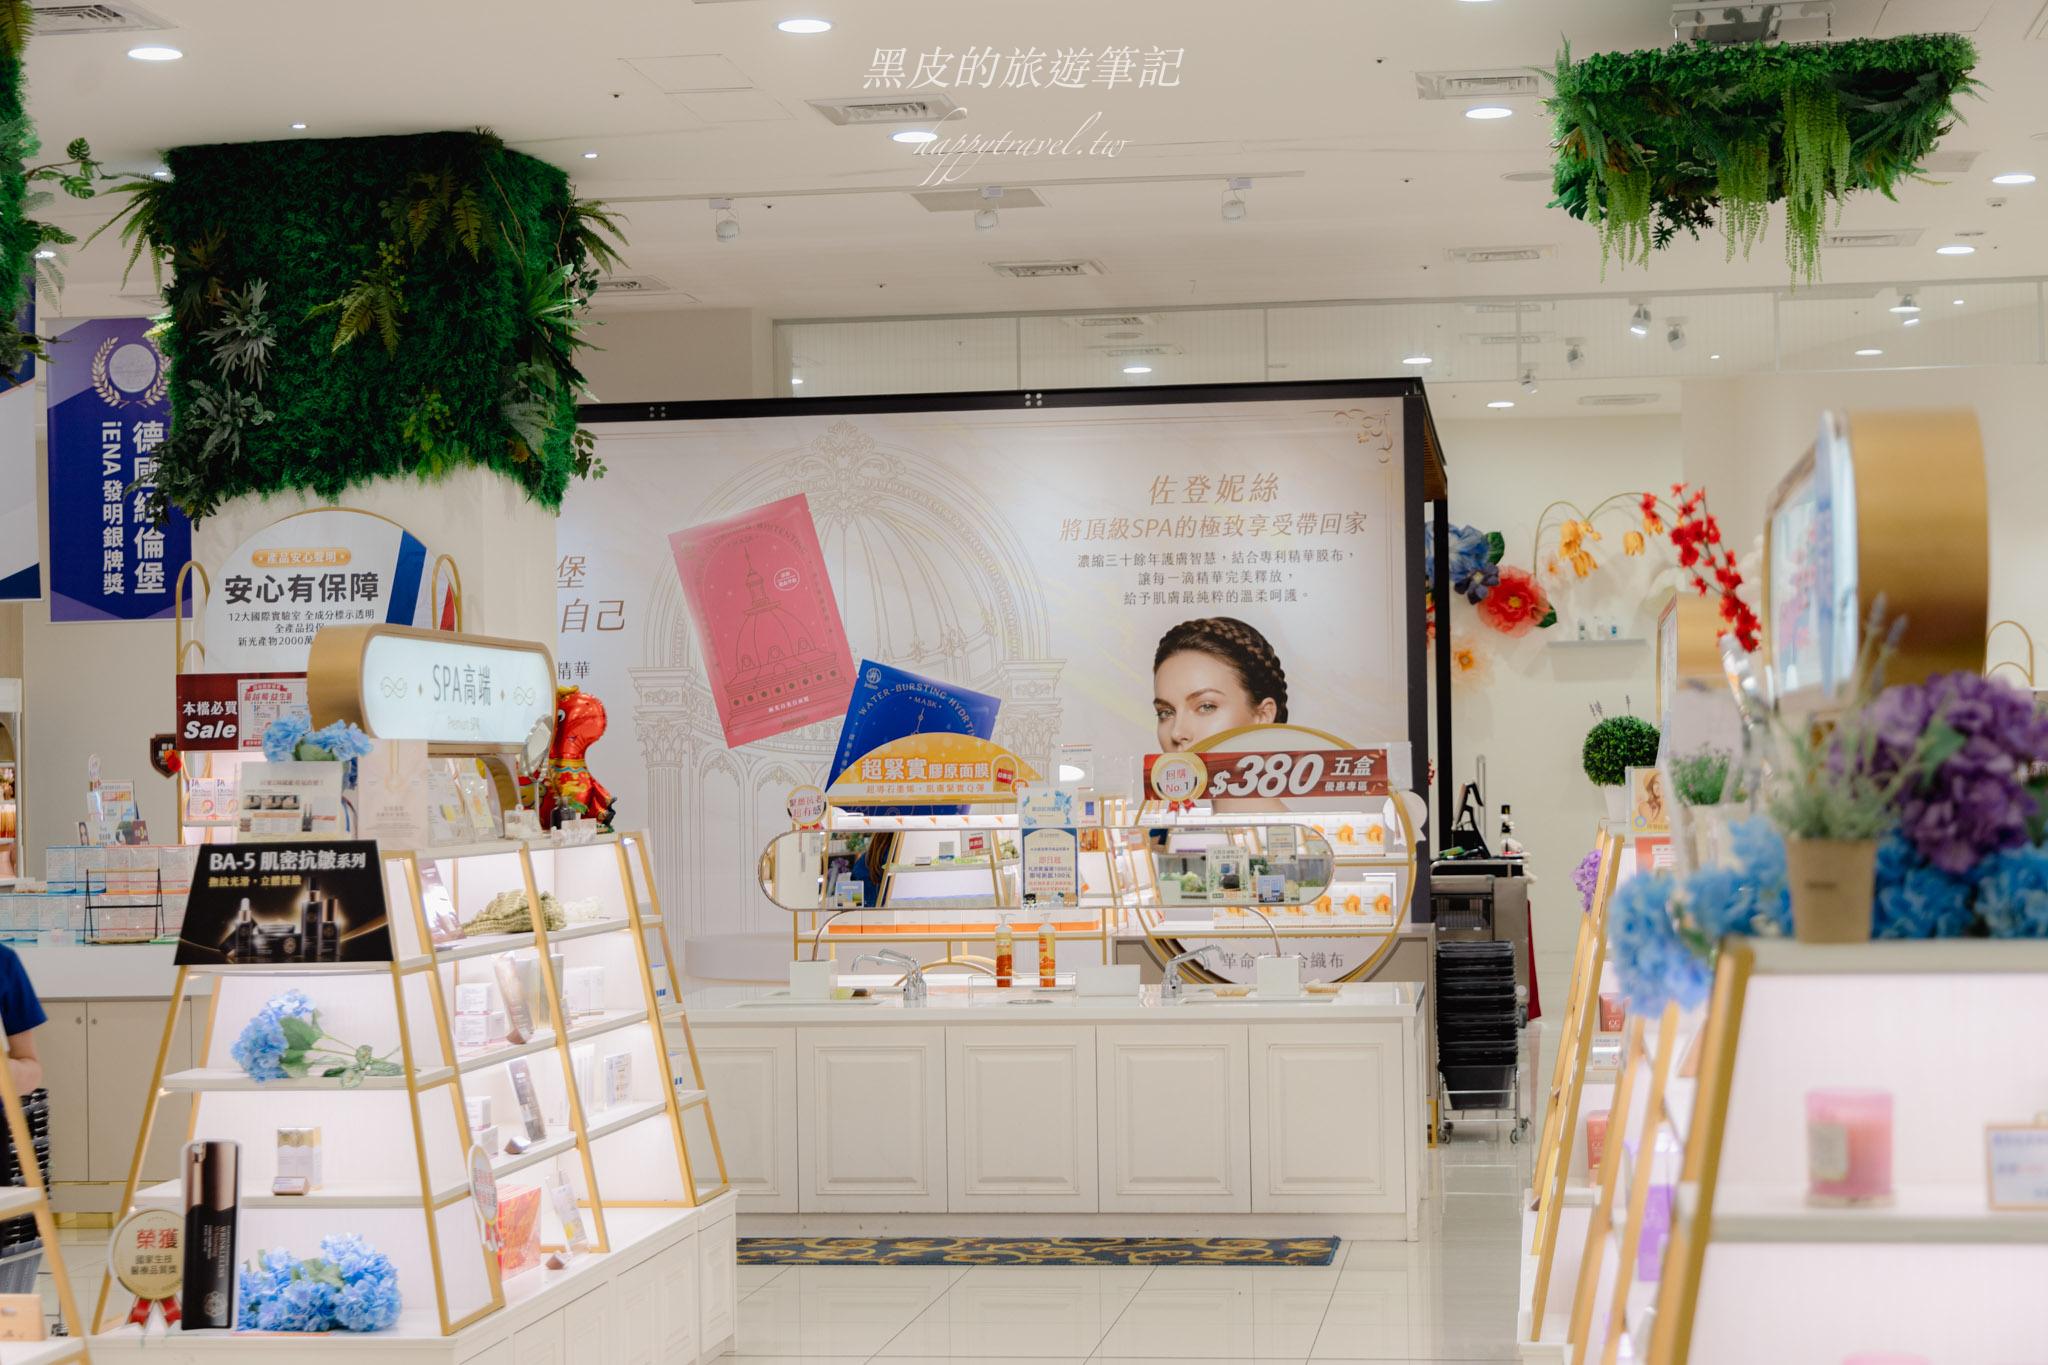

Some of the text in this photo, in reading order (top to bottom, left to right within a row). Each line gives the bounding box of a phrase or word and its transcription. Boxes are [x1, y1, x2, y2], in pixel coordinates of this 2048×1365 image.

[1149, 472, 1280, 506] 佐登妮絲
[102, 421, 125, 595] iENA 發明銀牌獎
[1059, 512, 1368, 542] 將頂級SPA的極致享受帶回家
[557, 554, 587, 589] 堡
[225, 572, 379, 605] 安心有保障
[228, 608, 375, 623] 12大國際實驗室 全成分標示透明
[561, 598, 625, 633] 自己
[432, 664, 492, 706] SPA高端
[183, 700, 238, 716] 本檔必買
[184, 720, 237, 739] Sale
[1209, 754, 1325, 797] $380
[1330, 756, 1374, 777] 五盒
[209, 852, 256, 871] BA-5
[1222, 952, 1344, 970] 革命合織布
[136, 1228, 179, 1249] 榮獲
